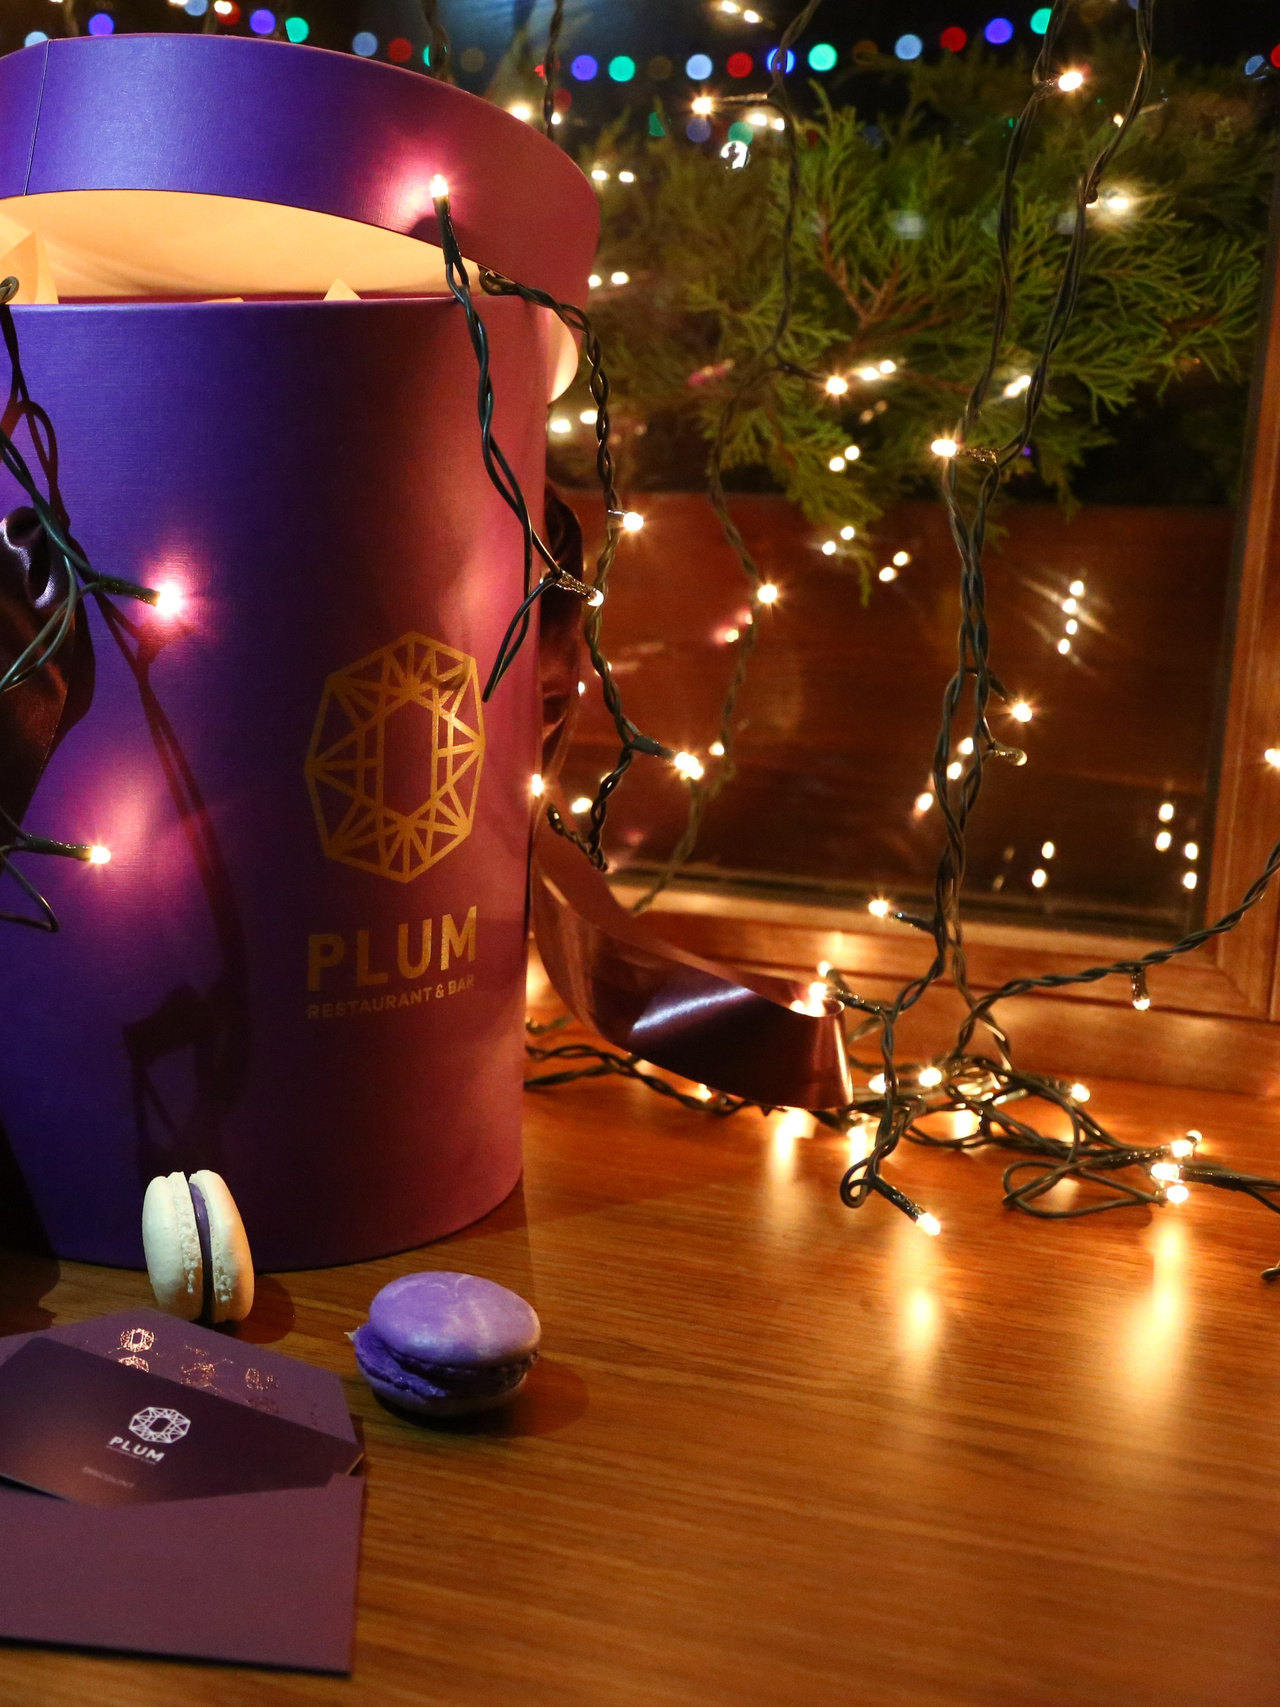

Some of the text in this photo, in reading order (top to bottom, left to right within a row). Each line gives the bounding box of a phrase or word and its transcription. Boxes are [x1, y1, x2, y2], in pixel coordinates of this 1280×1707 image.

[307, 905, 477, 991] PLUM
[307, 974, 475, 1019] RESTAURANT & BAR
[109, 1435, 166, 1462] PLUM
